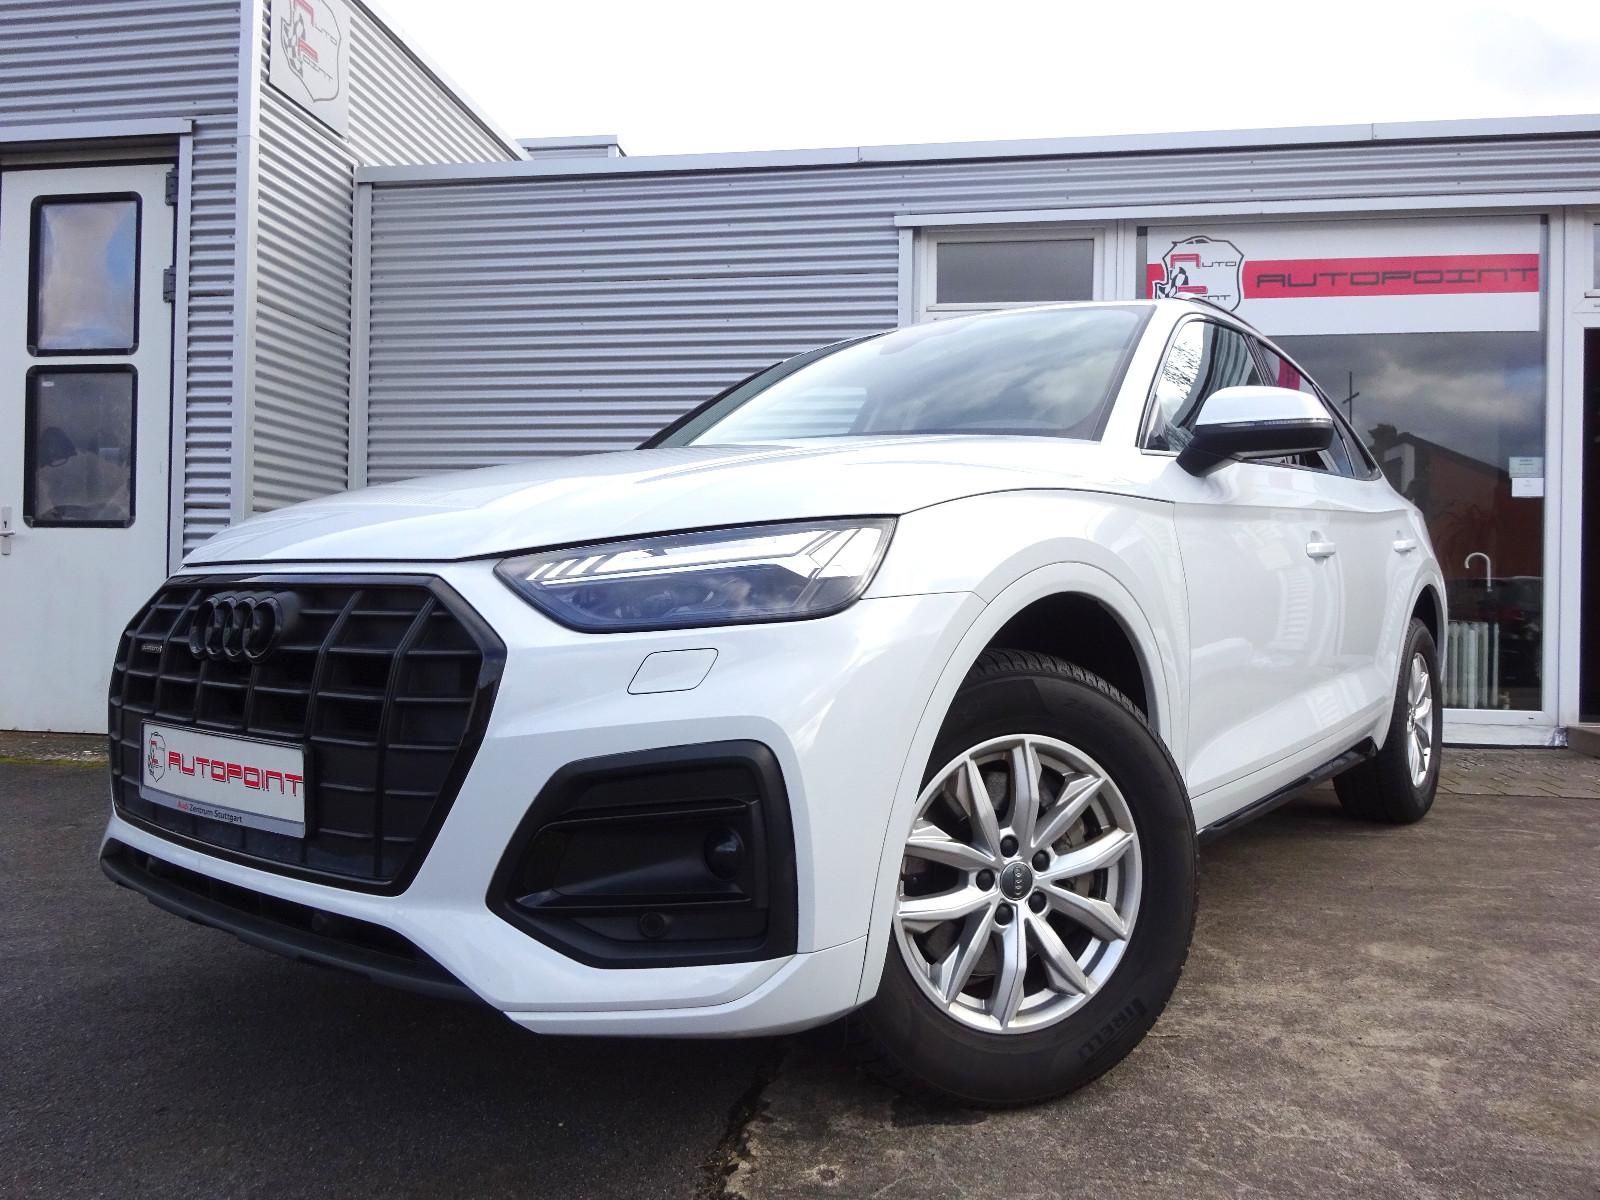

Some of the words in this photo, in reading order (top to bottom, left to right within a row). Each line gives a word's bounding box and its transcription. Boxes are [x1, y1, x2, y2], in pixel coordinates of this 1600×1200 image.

[1170, 253, 1237, 270] AUTO
[1256, 268, 1539, 288] AUTOPOINT
[168, 751, 304, 797] AUTOPOINT
[189, 803, 214, 816] Zentrum
[214, 809, 243, 823] Stuttgart
